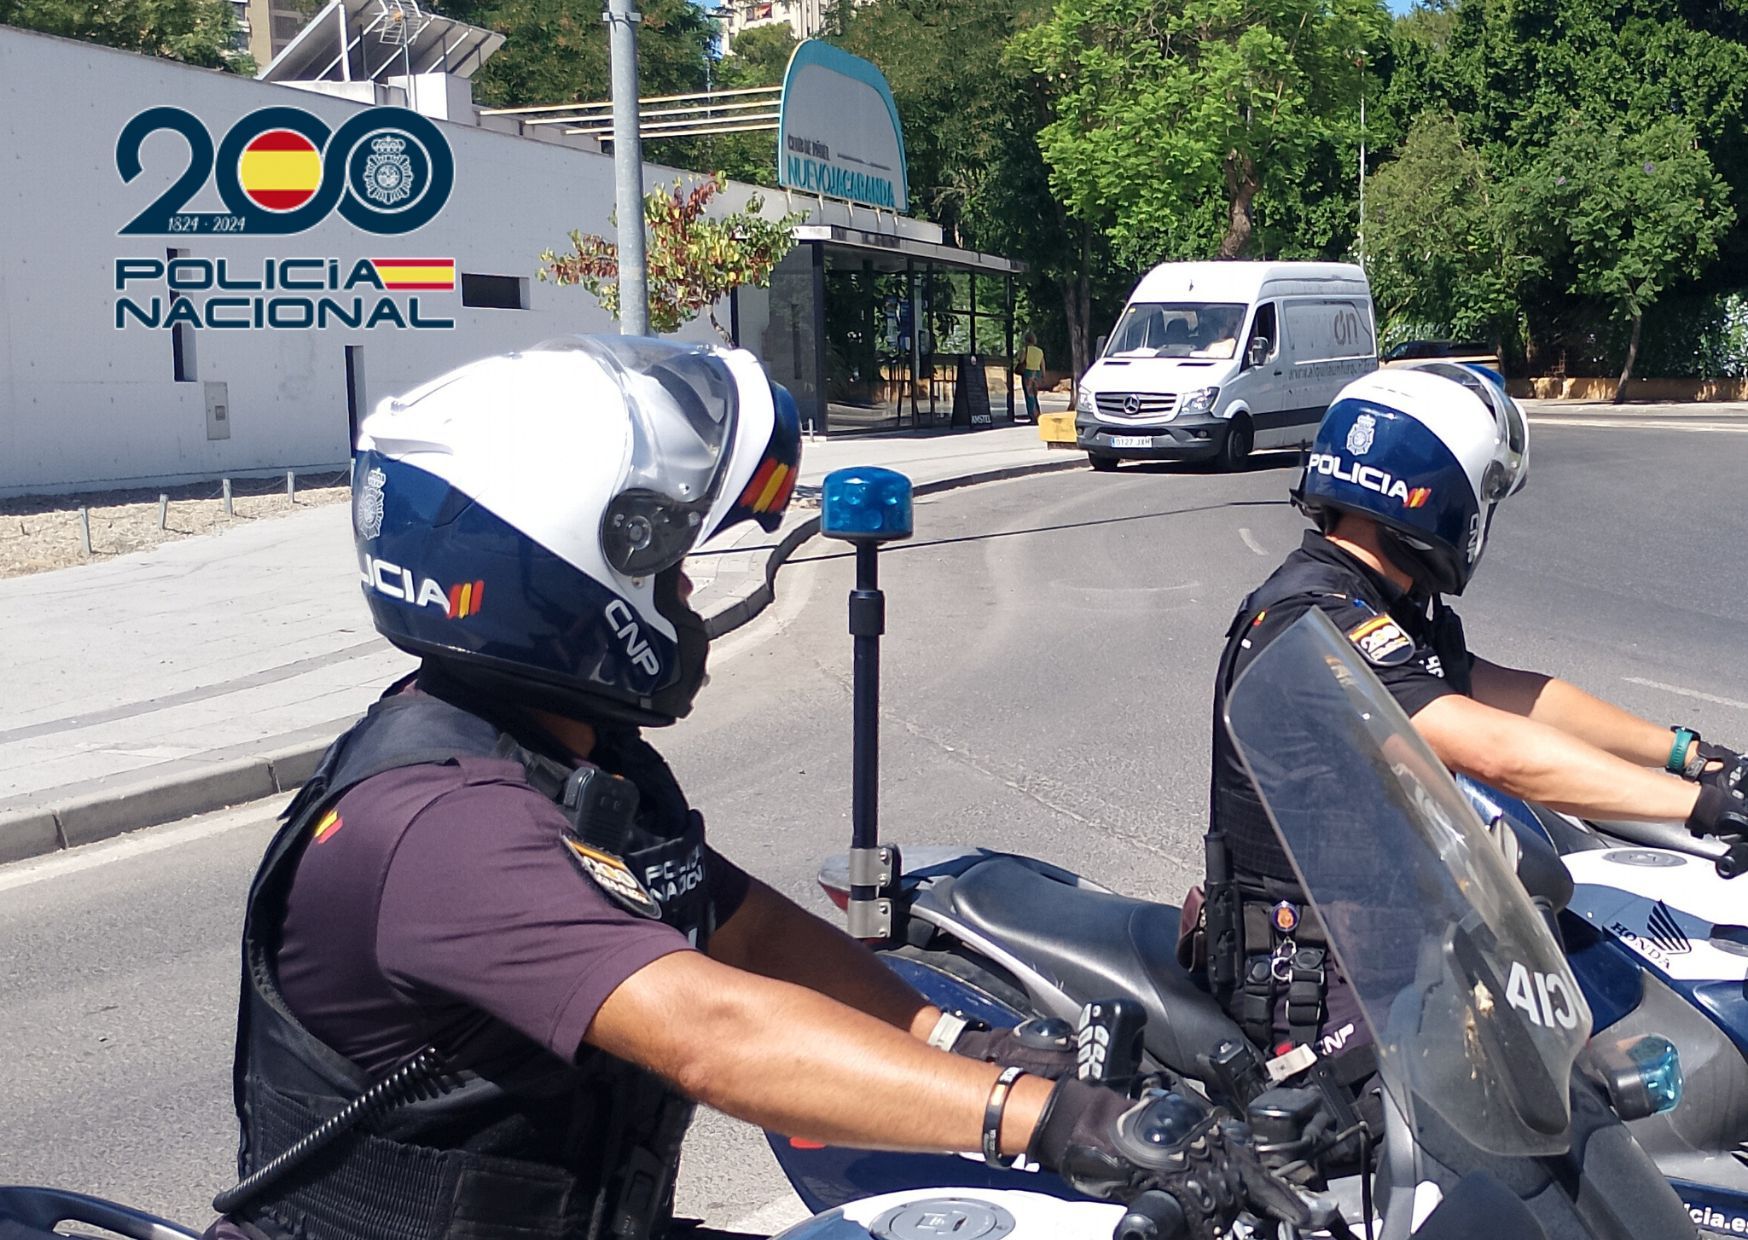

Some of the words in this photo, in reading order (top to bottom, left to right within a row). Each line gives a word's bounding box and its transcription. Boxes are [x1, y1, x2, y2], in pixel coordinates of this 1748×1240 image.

[1308, 453, 1409, 504] POLICIA
[605, 599, 660, 675] CNP
[1611, 921, 1671, 969] HONDA
[1683, 1203, 1748, 1236] cia.e
